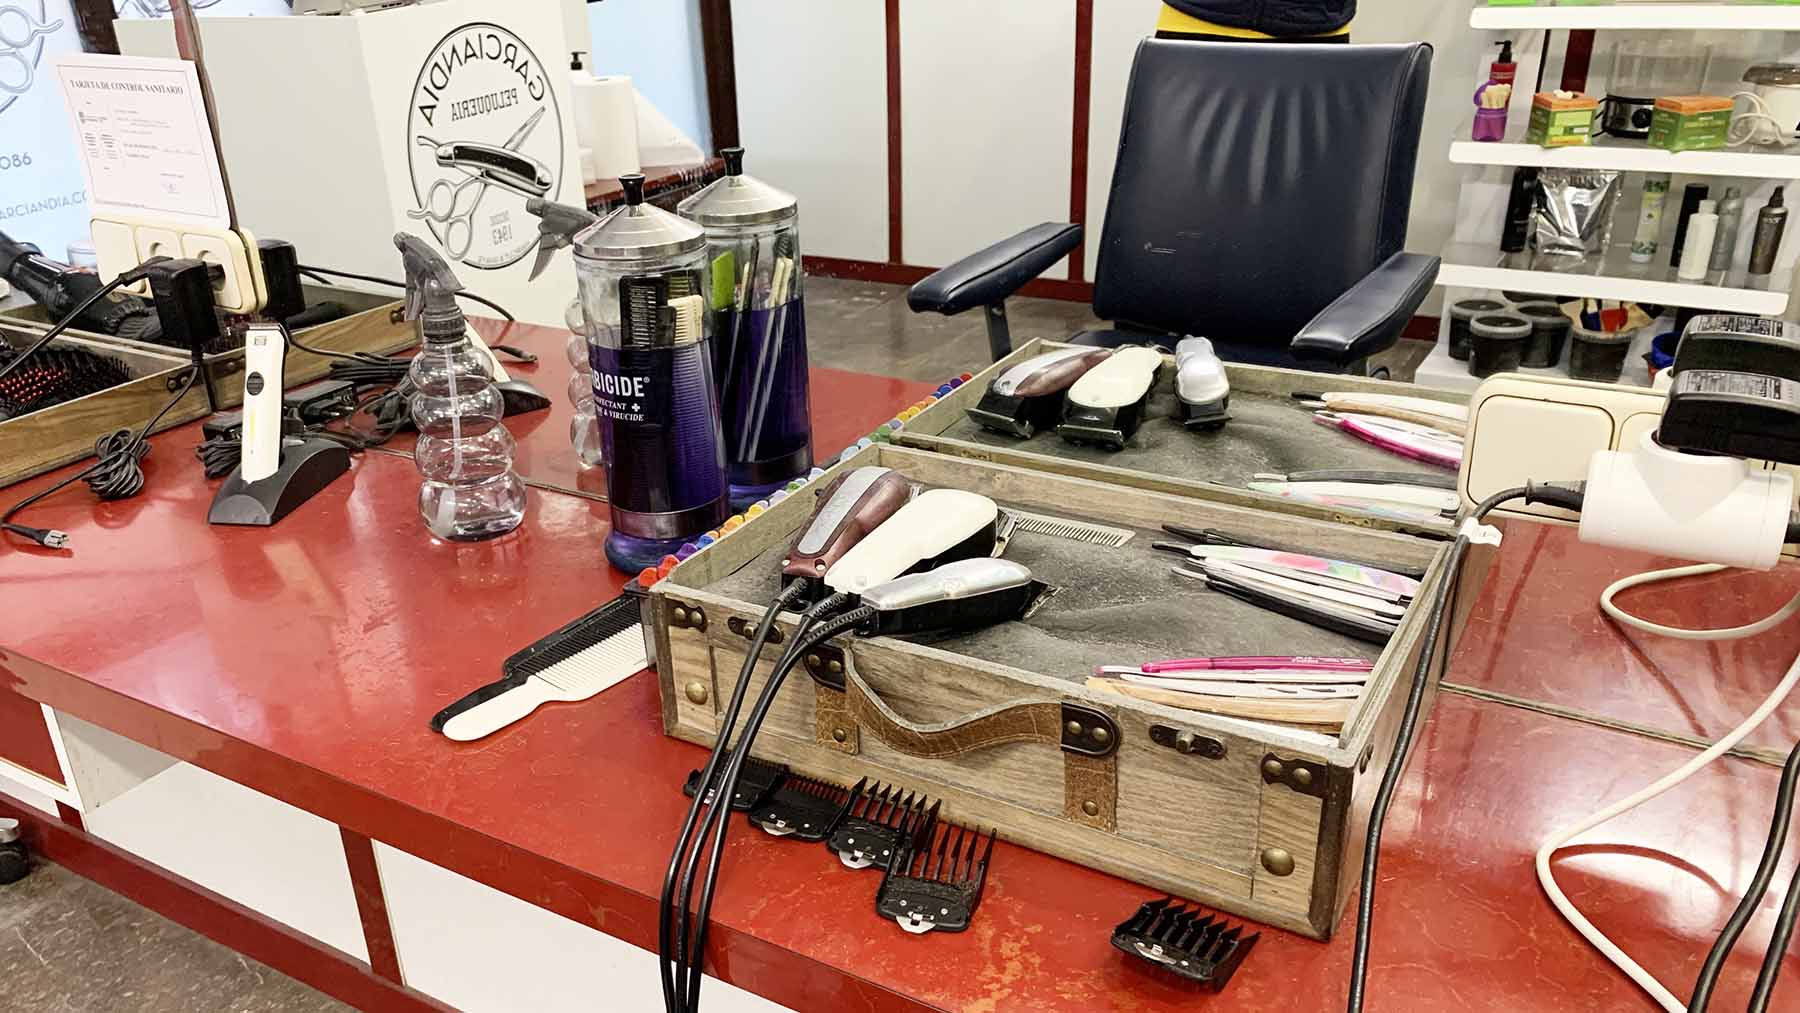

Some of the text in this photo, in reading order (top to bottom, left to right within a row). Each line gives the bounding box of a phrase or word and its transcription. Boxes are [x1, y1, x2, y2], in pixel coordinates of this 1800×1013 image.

[70, 79, 100, 89] TARJETA
[111, 82, 145, 92] CONTROL
[145, 84, 184, 95] SANITARIO
[609, 411, 644, 421] VIRUCIDE
